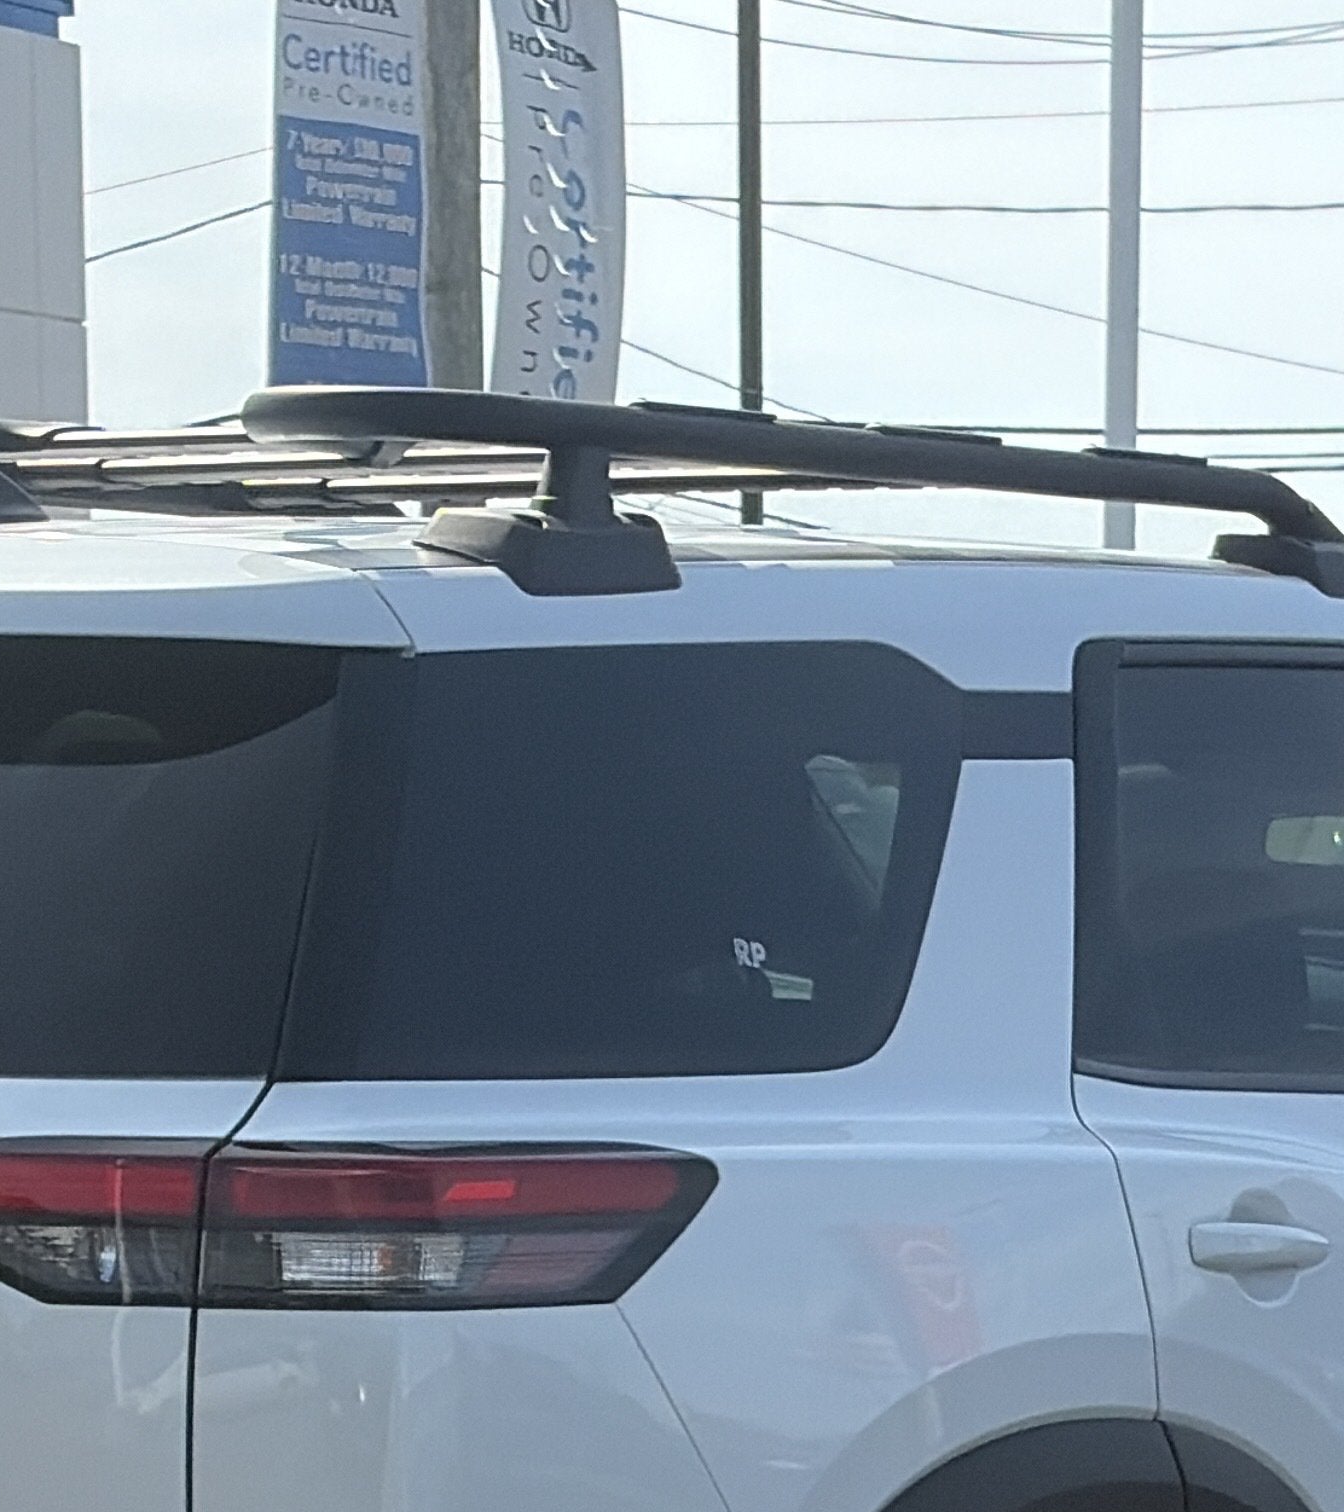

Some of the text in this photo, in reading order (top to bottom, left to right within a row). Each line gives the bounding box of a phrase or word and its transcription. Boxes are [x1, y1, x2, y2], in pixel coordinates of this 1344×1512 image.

[283, 33, 412, 86] Certified
[292, 0, 399, 18] NDA
[520, 105, 553, 396] Pre-Own
[554, 108, 601, 399] Certifie
